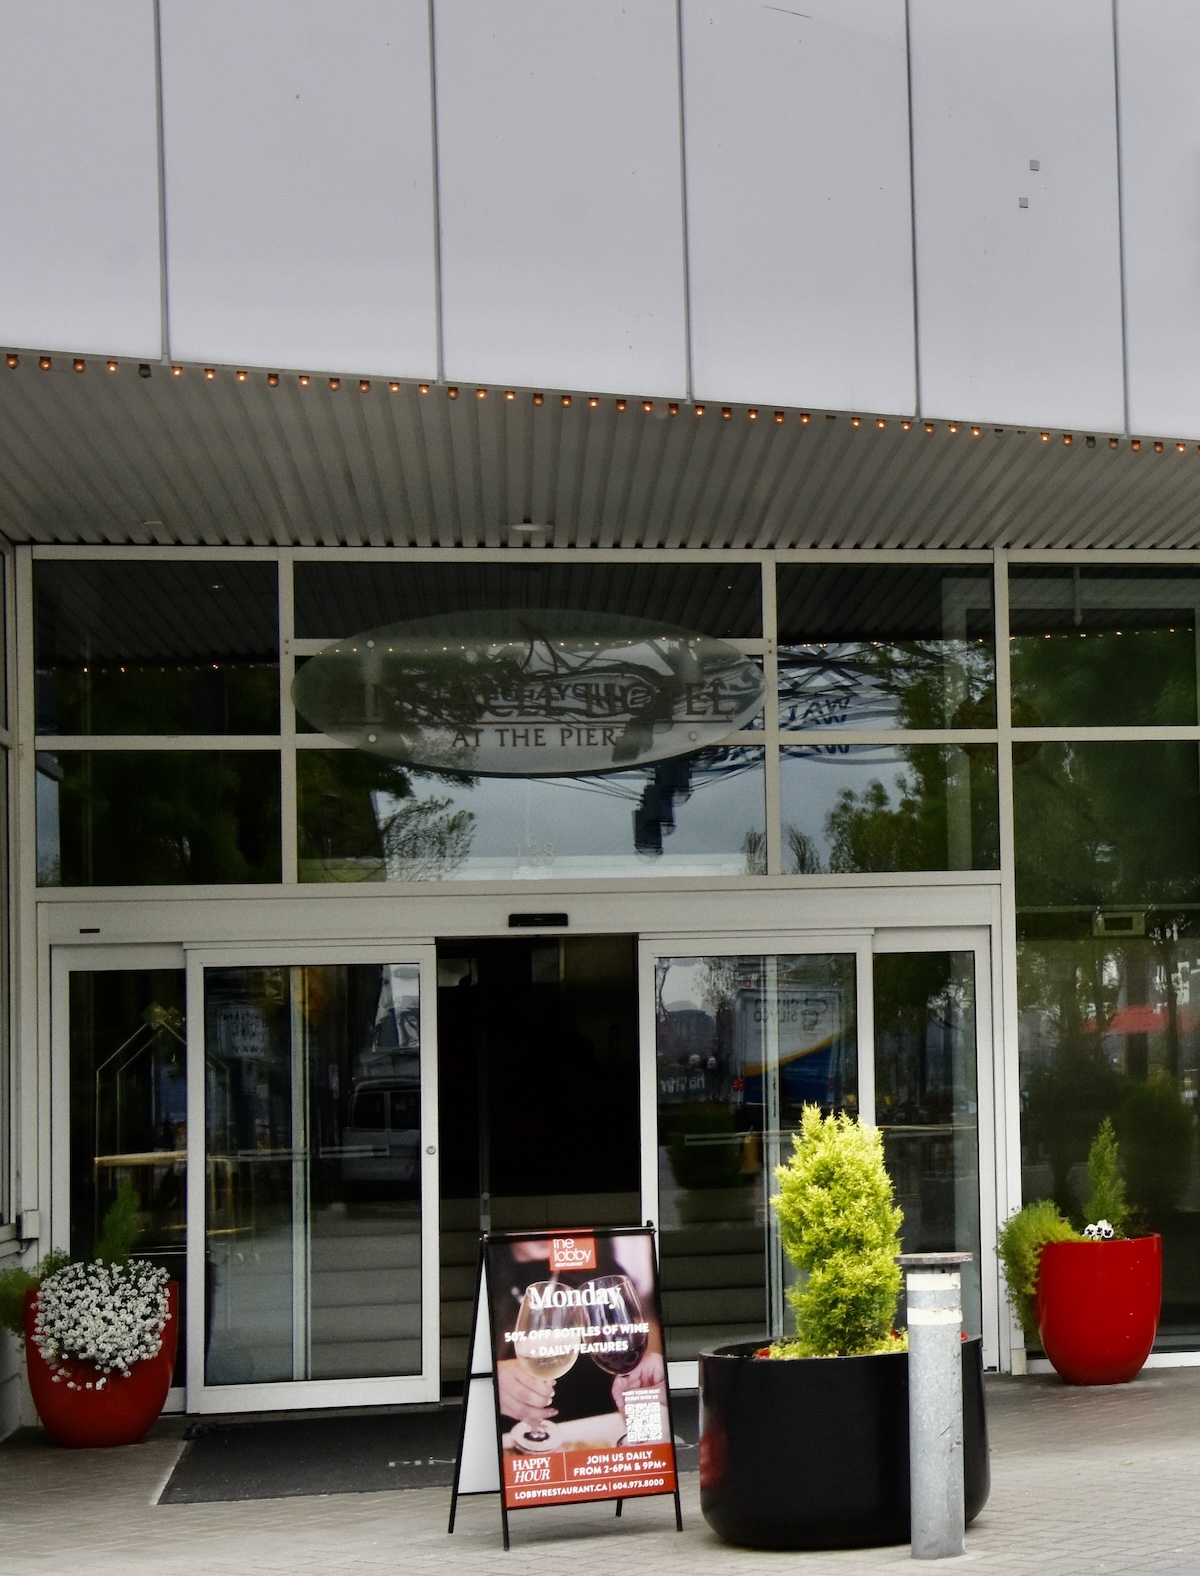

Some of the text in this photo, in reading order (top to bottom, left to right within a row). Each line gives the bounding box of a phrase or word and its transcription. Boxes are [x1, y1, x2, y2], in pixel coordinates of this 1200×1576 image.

[585, 682, 736, 716] HOEL
[451, 728, 618, 747] AT THE PIER
[554, 1248, 592, 1263] lobby
[528, 1281, 622, 1310] Monday
[504, 1322, 650, 1343] 50% OFF BOTTLES OF WINE
[539, 1344, 574, 1357] DAILY
[574, 1341, 629, 1355] FEATURES
[512, 1457, 551, 1471] HAPPY
[586, 1450, 653, 1464] JOIN US DAILY
[514, 1469, 551, 1483] HOUR
[573, 1460, 667, 1477] FROM 2-6PM & 9PM+
[514, 1478, 665, 1500] LOBBYRESTAURANT.CA 604.973.8000
